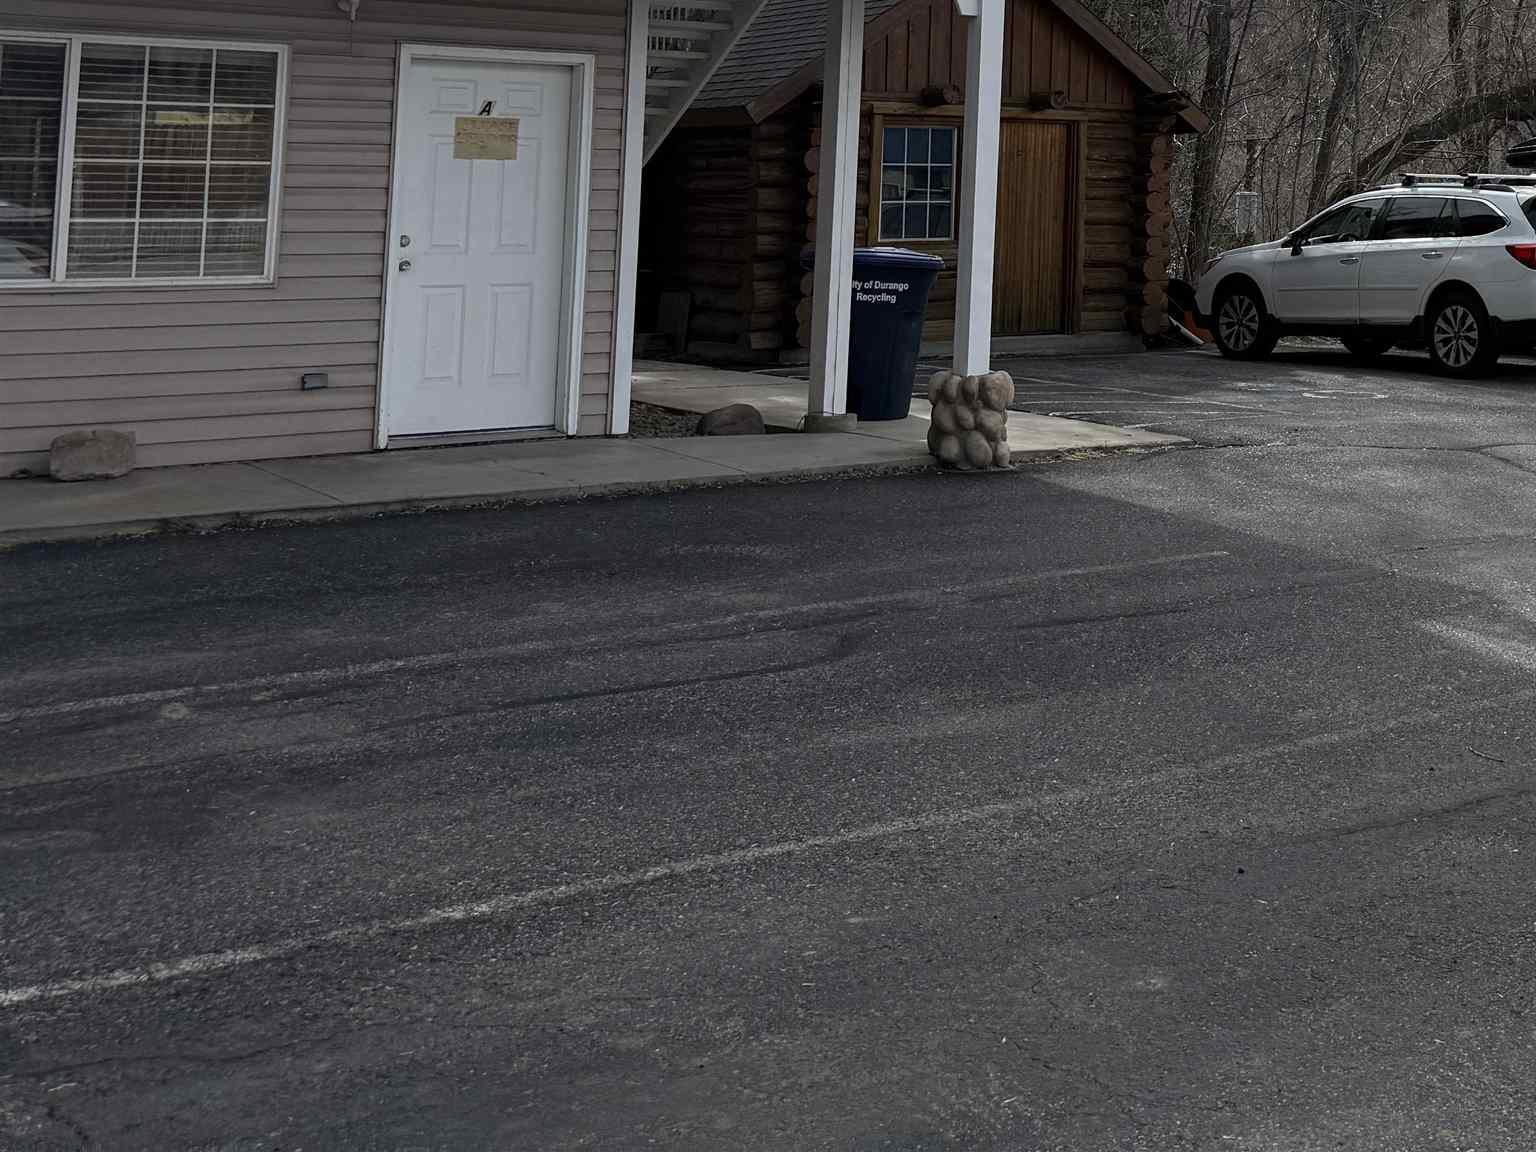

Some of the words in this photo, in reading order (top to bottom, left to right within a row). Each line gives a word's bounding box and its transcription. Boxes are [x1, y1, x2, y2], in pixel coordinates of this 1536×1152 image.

[479, 101, 494, 116] A
[852, 280, 863, 290] ity
[864, 280, 874, 289] of
[874, 280, 909, 292] Durango
[856, 292, 897, 304] Recycling
